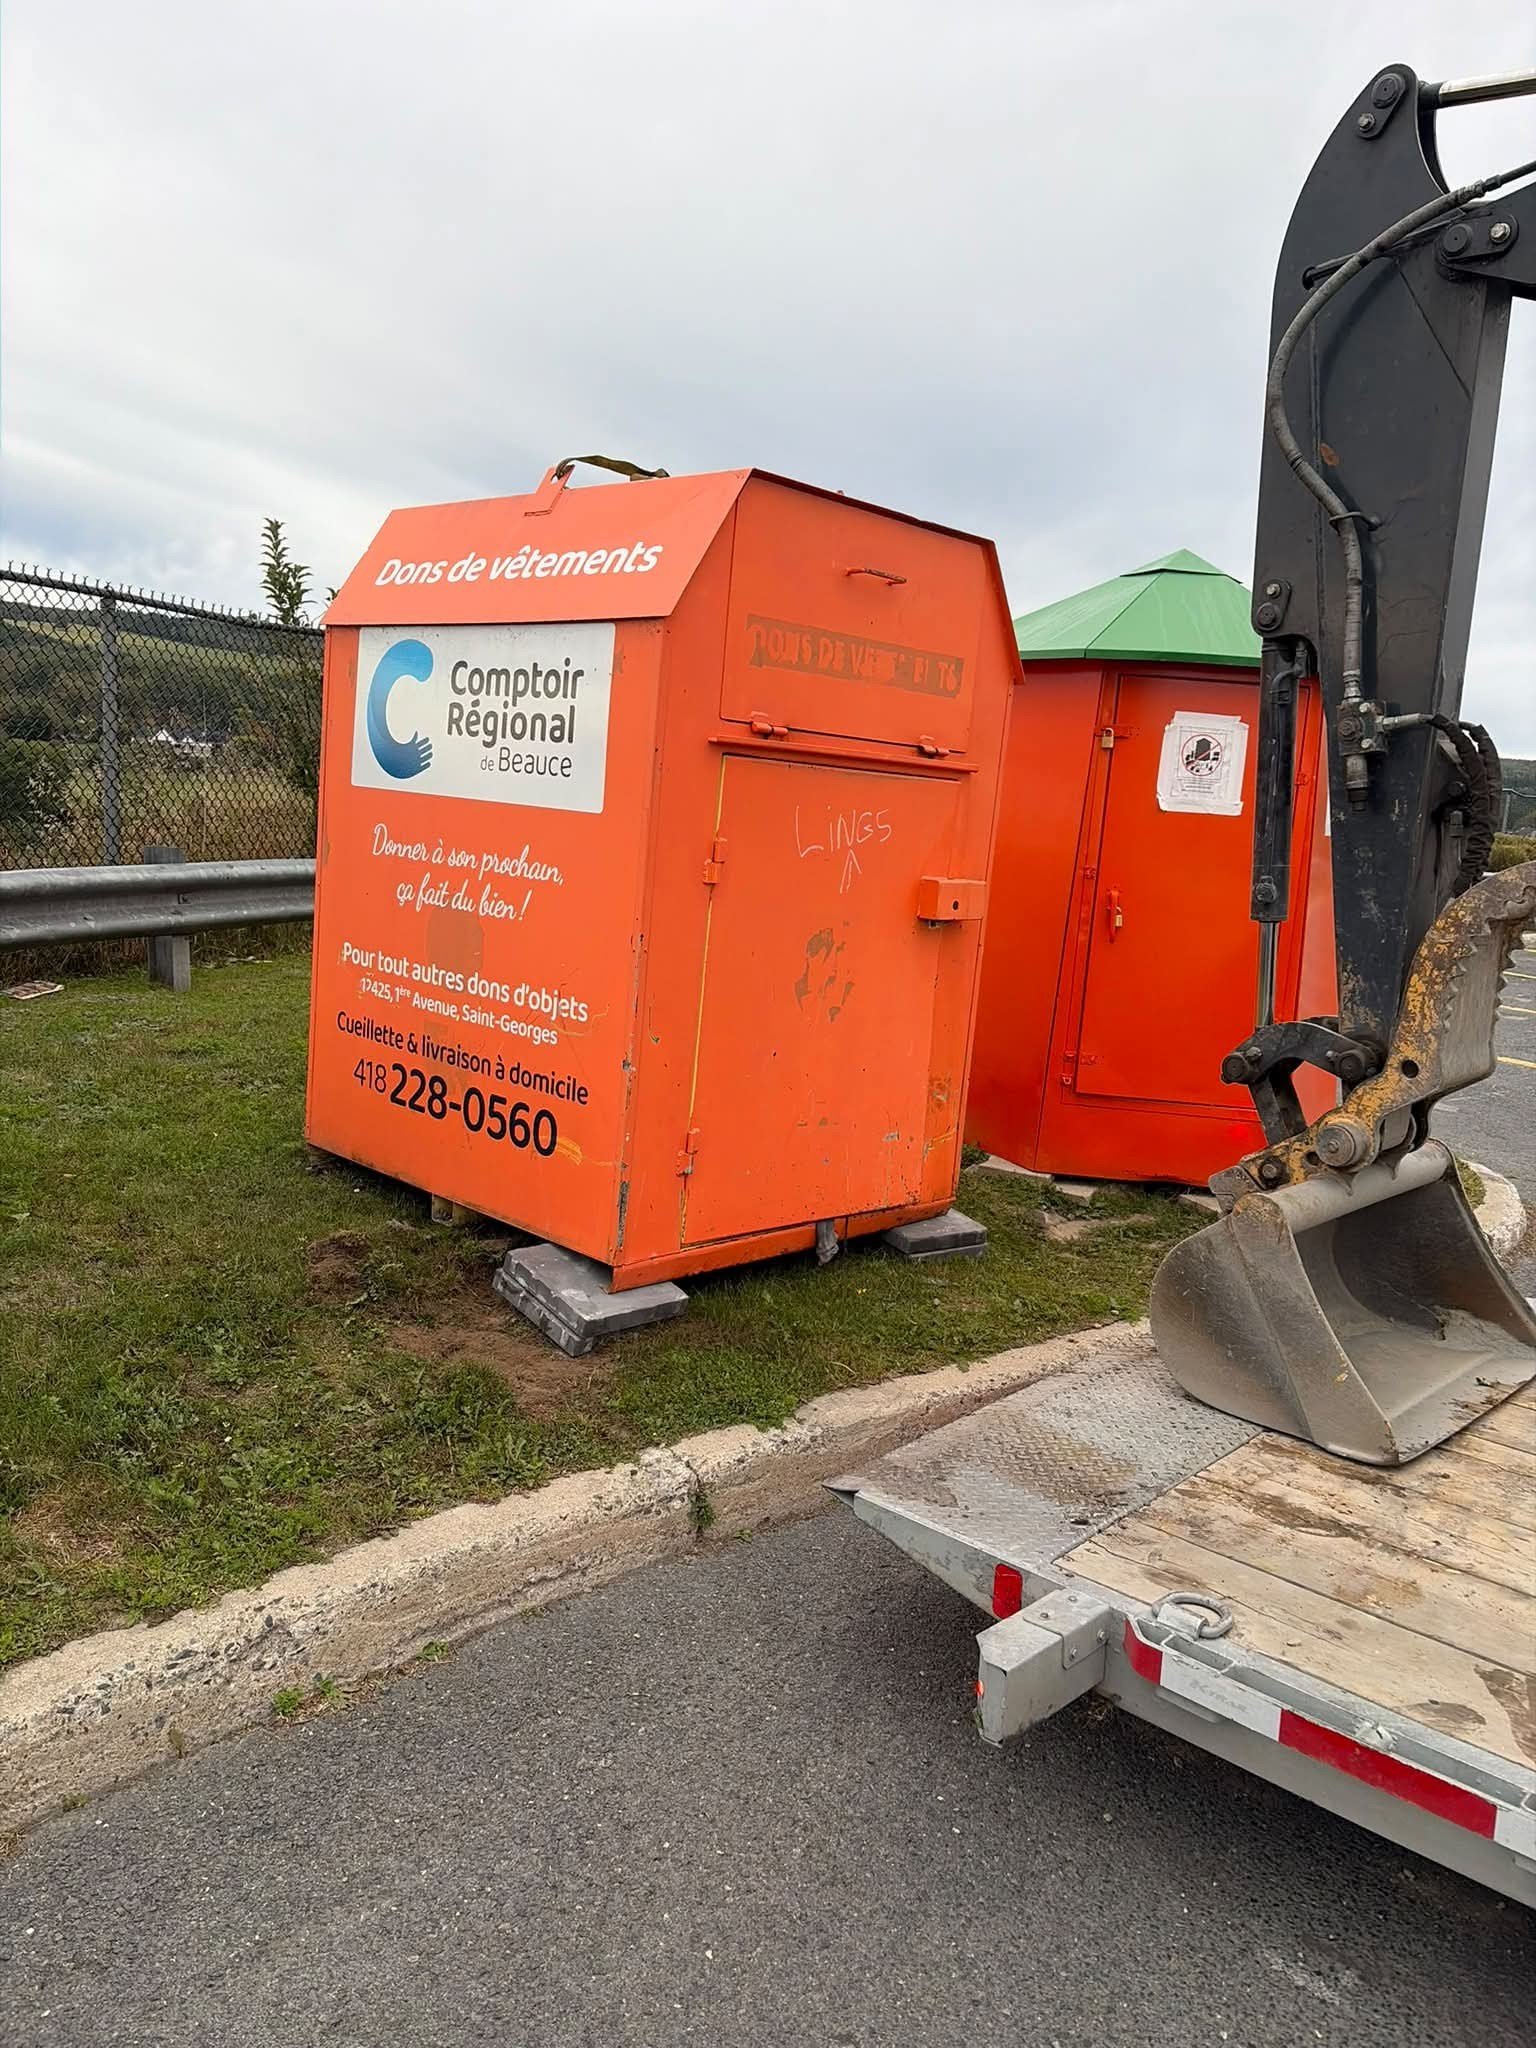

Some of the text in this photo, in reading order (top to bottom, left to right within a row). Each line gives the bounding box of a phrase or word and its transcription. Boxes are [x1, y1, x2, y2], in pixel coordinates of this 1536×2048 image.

[375, 541, 663, 586] Dons de vêtements
[450, 657, 584, 706] Comptoir
[447, 699, 575, 748] Régional
[480, 747, 572, 778] de Beauce
[372, 823, 564, 886] Donner à son prochain,
[396, 882, 415, 906] ça
[416, 872, 450, 912] fait
[451, 879, 476, 912] du
[479, 883, 517, 920] bien
[343, 941, 589, 1023] Pour tout autres dons d'objets
[411, 992, 460, 1021] Avenue,
[462, 1004, 558, 1046] Saint-Georges
[337, 1011, 589, 1105] Cueillette & livraison à domicile
[353, 1058, 558, 1157] 418 228-0560
